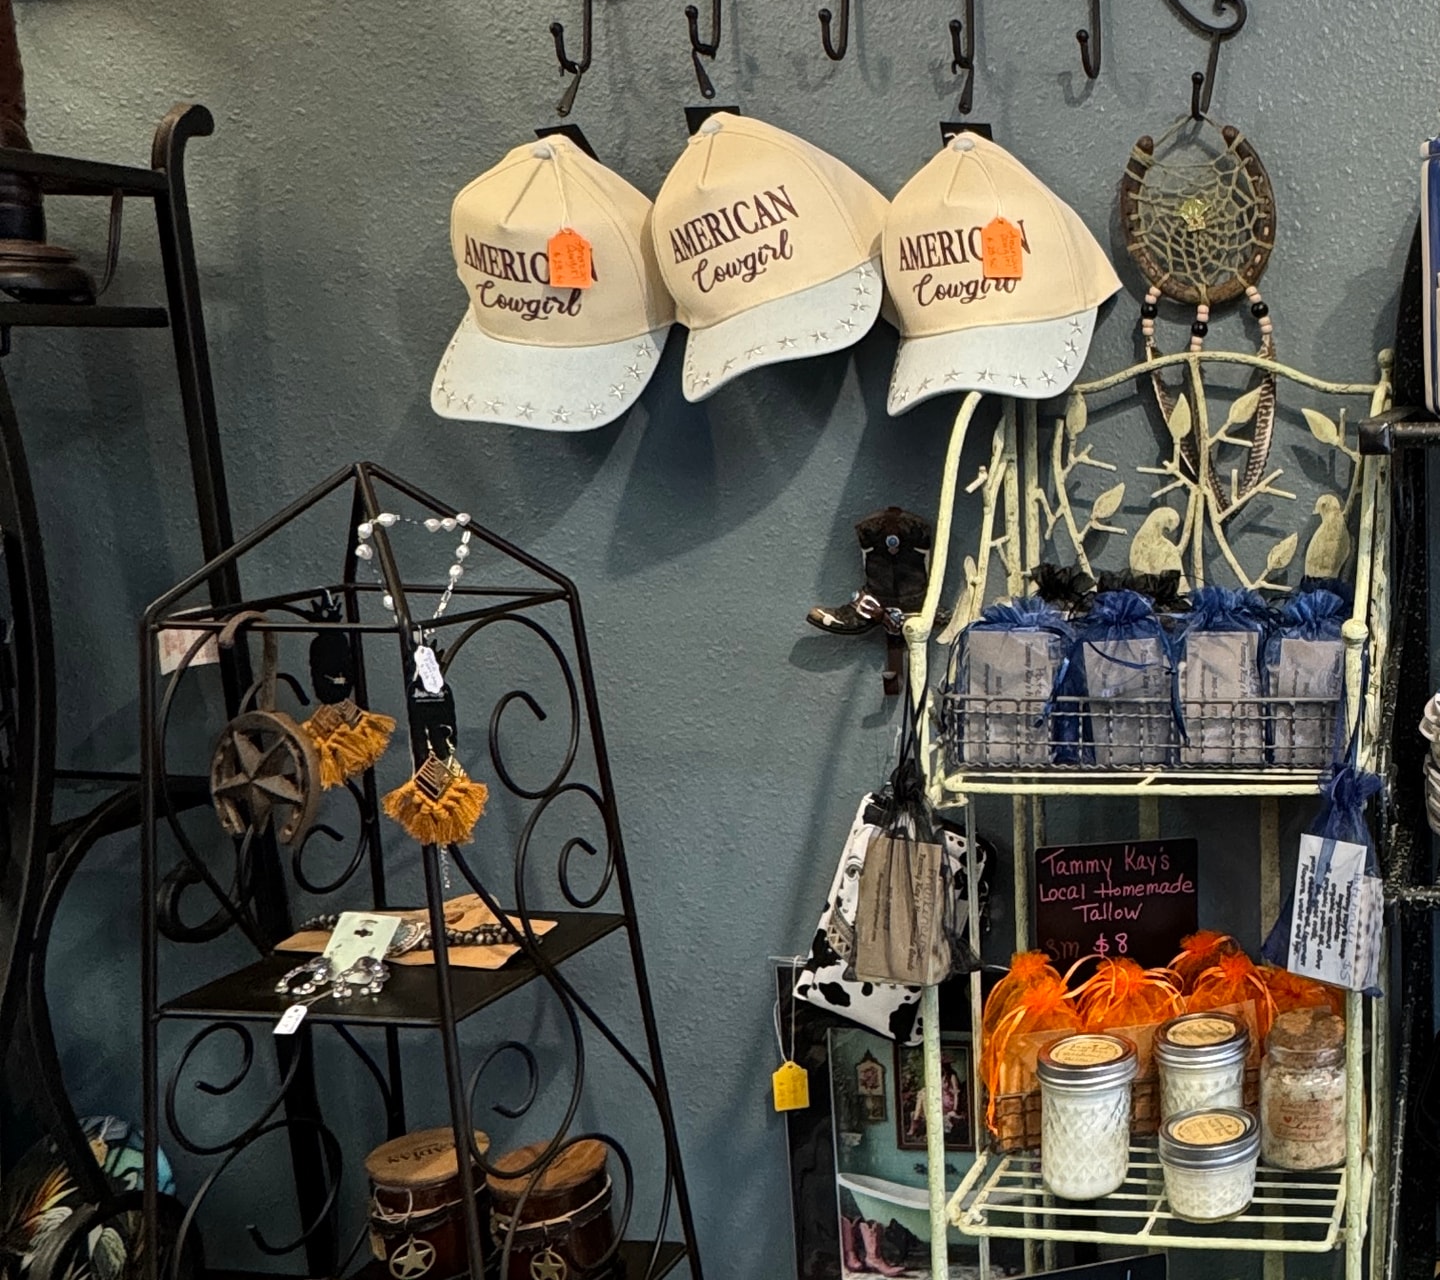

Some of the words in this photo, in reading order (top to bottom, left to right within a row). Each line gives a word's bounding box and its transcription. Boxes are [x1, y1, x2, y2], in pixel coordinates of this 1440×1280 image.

[669, 185, 799, 264] AMERICAN
[899, 219, 1031, 272] AMERICN
[464, 234, 598, 285] AMERIC
[692, 229, 793, 293] Cowgirl
[476, 280, 582, 321] Cowgirl
[1041, 849, 1113, 878] Tammy
[1124, 846, 1170, 875] Kay's
[1039, 880, 1085, 902] Local
[1094, 873, 1195, 898] Homemade
[1073, 902, 1143, 923] Tallow
